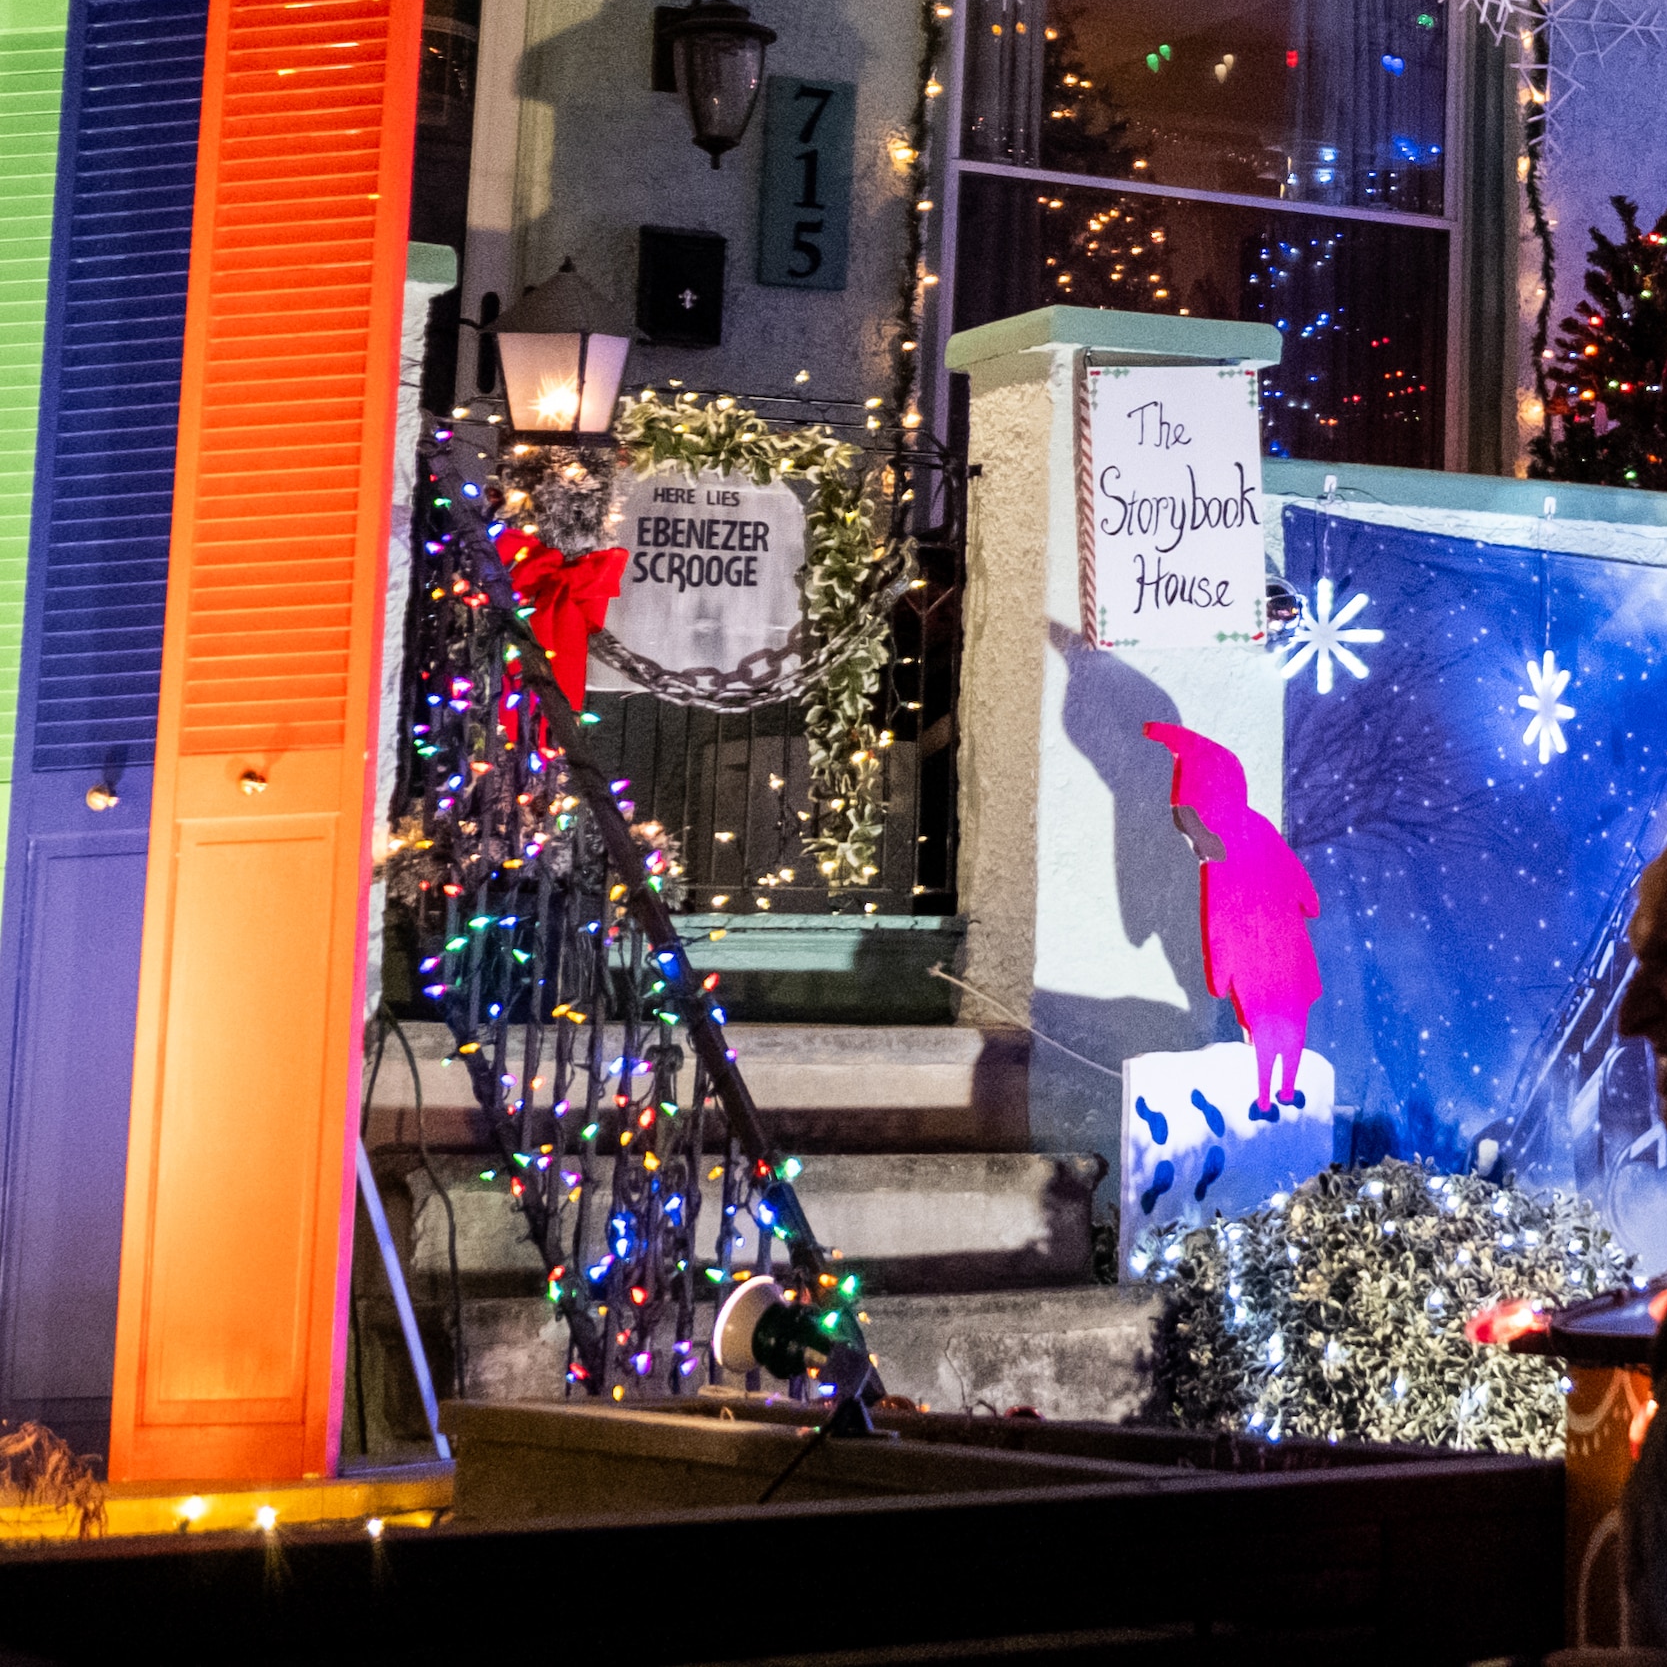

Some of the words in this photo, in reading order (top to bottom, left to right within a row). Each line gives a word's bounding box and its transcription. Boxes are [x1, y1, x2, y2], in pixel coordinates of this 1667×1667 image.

[786, 85, 834, 279] 715
[1126, 400, 1192, 450] The
[653, 486, 696, 505] HERE
[706, 490, 741, 507] LIES
[1100, 461, 1260, 554] Storybook
[636, 516, 770, 552] EBENEZER
[632, 551, 758, 593] SCROOGE
[1133, 554, 1234, 614] House
